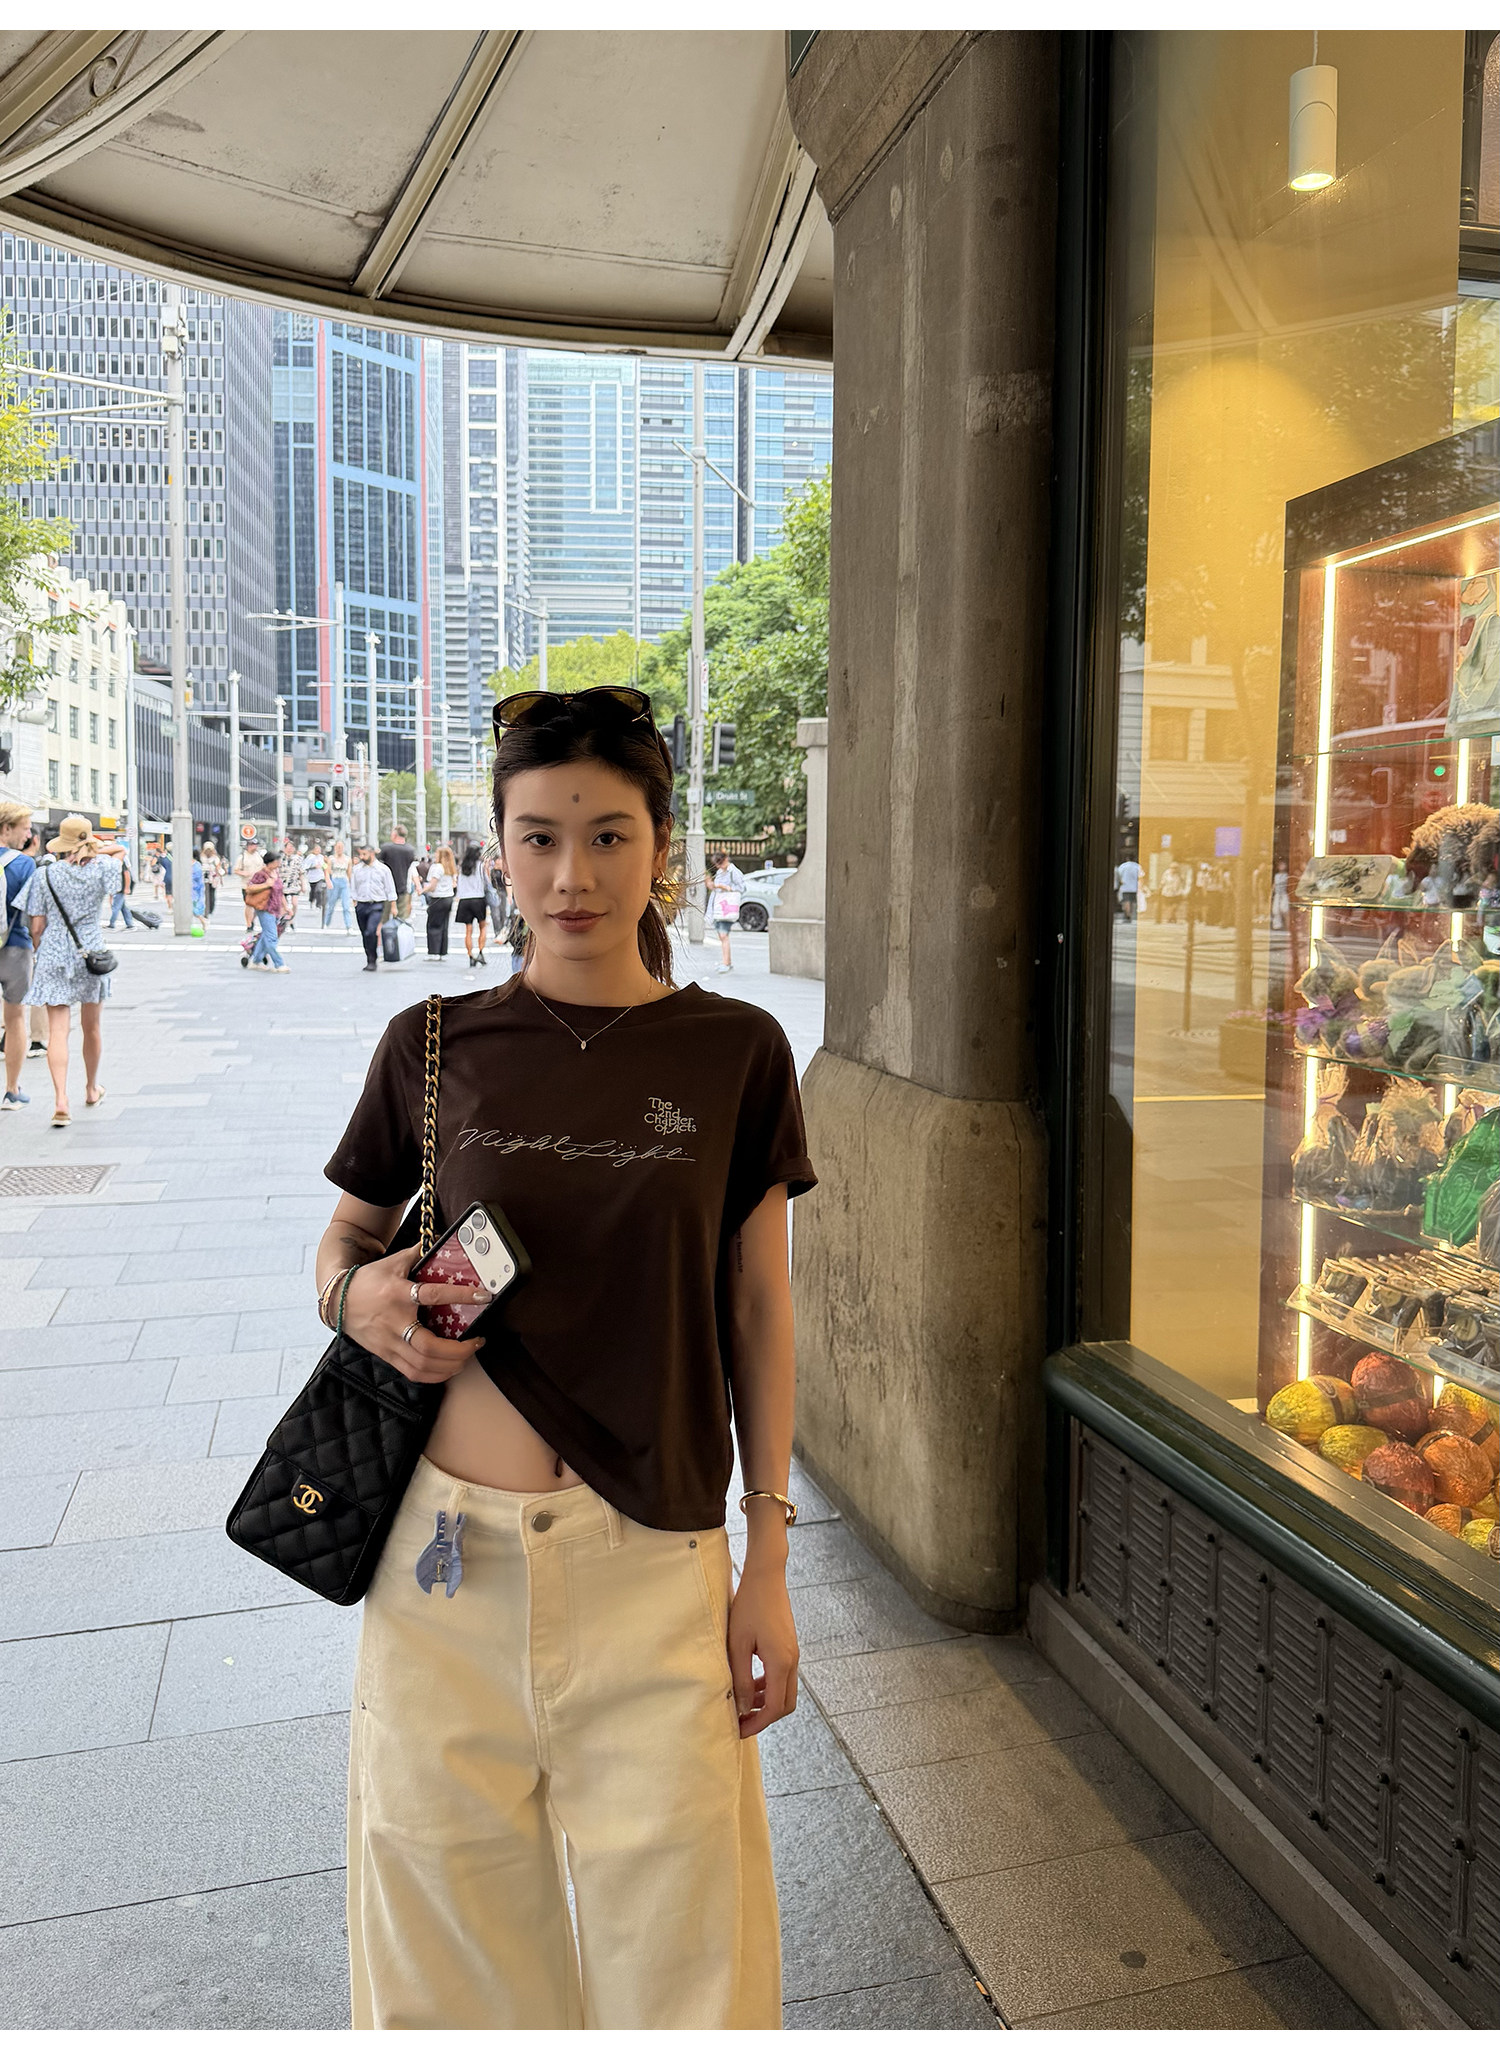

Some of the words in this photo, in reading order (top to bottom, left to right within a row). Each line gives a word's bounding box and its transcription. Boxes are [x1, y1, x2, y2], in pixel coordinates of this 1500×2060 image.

[648, 1096, 673, 1110] The
[658, 1107, 681, 1118] 2nd
[644, 1112, 694, 1127] Chapter
[654, 1124, 668, 1136] of
[666, 1124, 697, 1134] Acts
